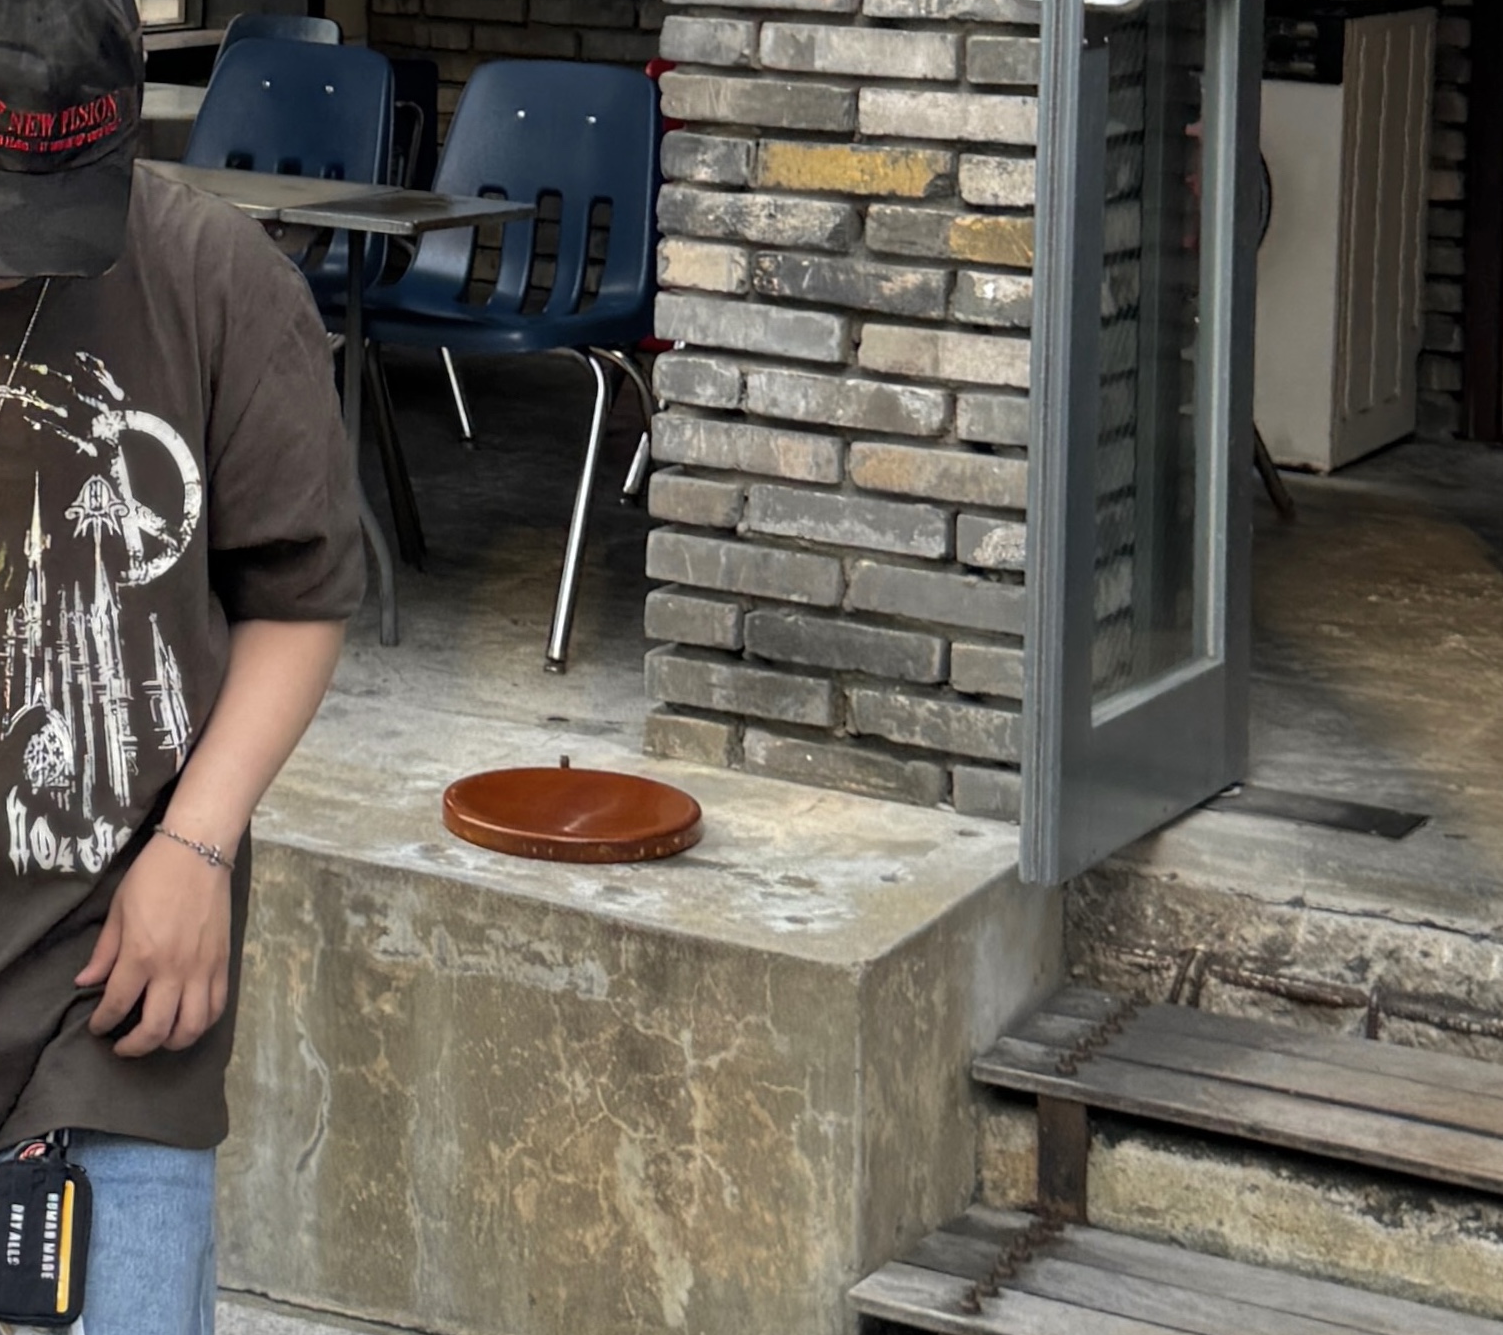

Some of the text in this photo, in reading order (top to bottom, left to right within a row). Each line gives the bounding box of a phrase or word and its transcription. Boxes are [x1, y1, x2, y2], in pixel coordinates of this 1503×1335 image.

[8, 110, 55, 138] NEW
[40, 1192, 60, 1280] HUMAN MADE
